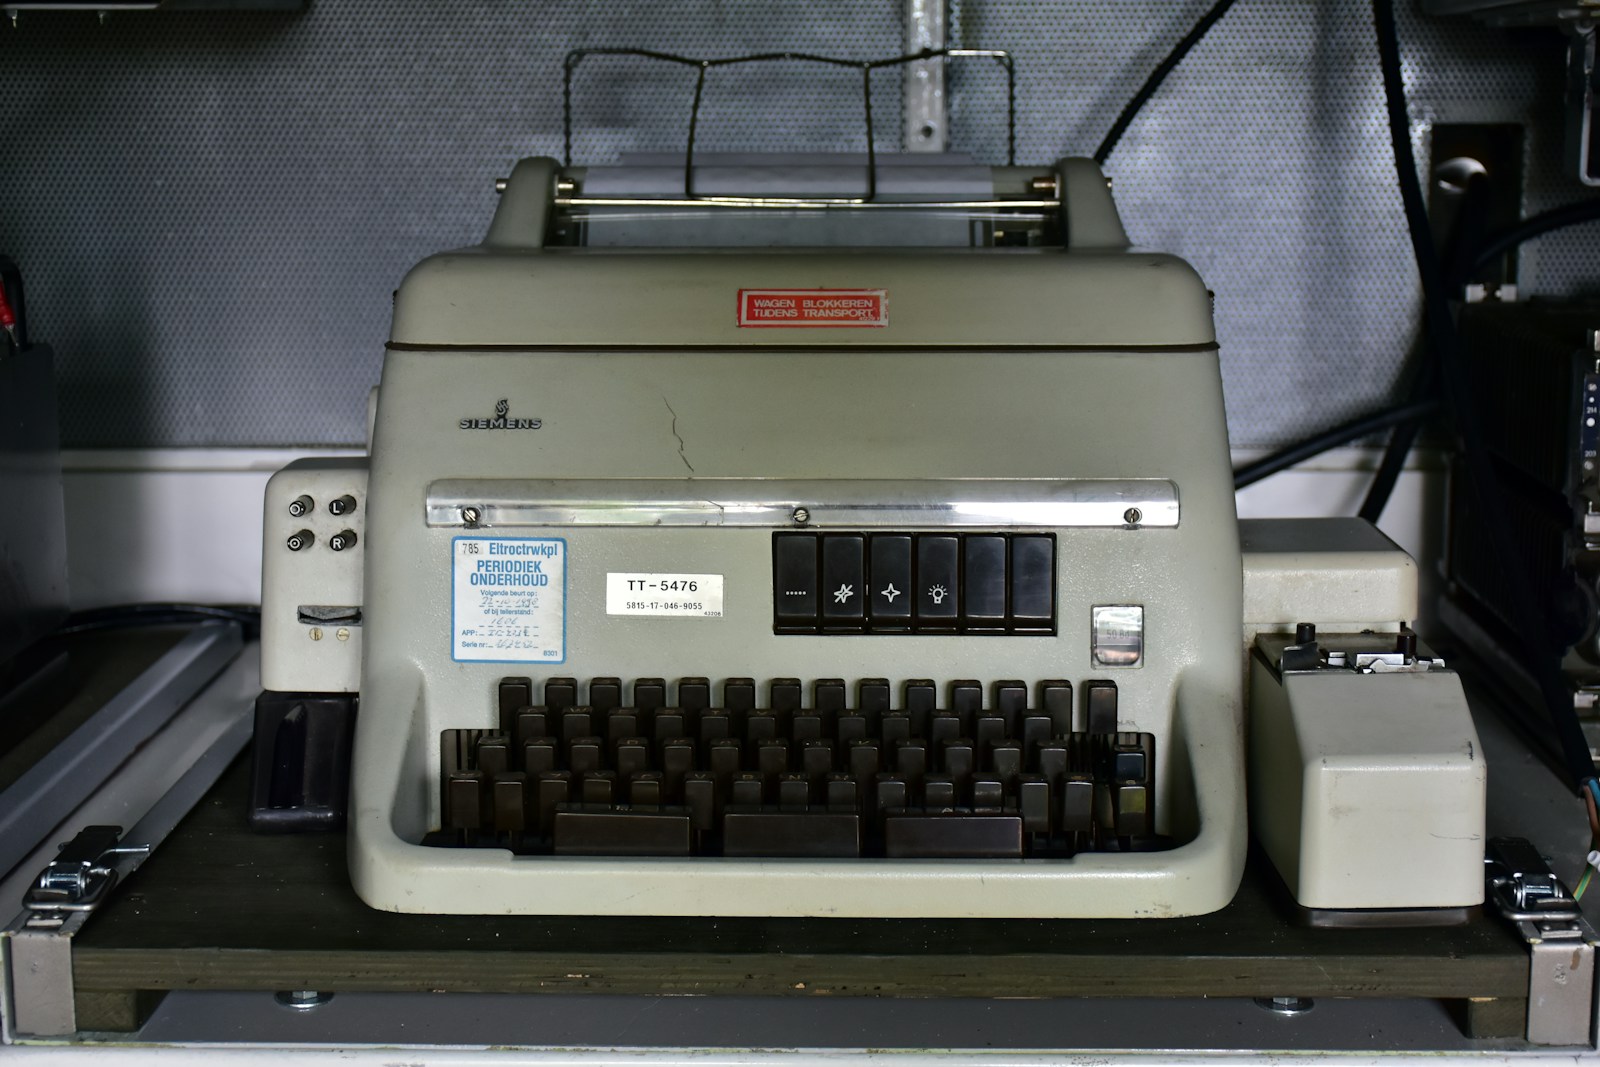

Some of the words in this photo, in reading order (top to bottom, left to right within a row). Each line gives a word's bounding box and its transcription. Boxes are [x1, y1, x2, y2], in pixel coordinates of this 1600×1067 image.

[753, 299, 796, 308] WAGEN
[802, 299, 873, 308] BLOKKEREN
[802, 308, 874, 317] TRANSPORT
[460, 418, 542, 429] SIEMENS
[333, 503, 341, 514] L
[333, 538, 342, 549] R
[462, 543, 480, 554] 785
[489, 542, 558, 558] Eltroctrwkpl
[477, 560, 542, 573] PERIODIEK
[470, 573, 548, 587] ONDERHOUD
[480, 589, 508, 597] Volgende
[626, 601, 703, 610] 5815-17-046-9055
[491, 608, 499, 616] bij
